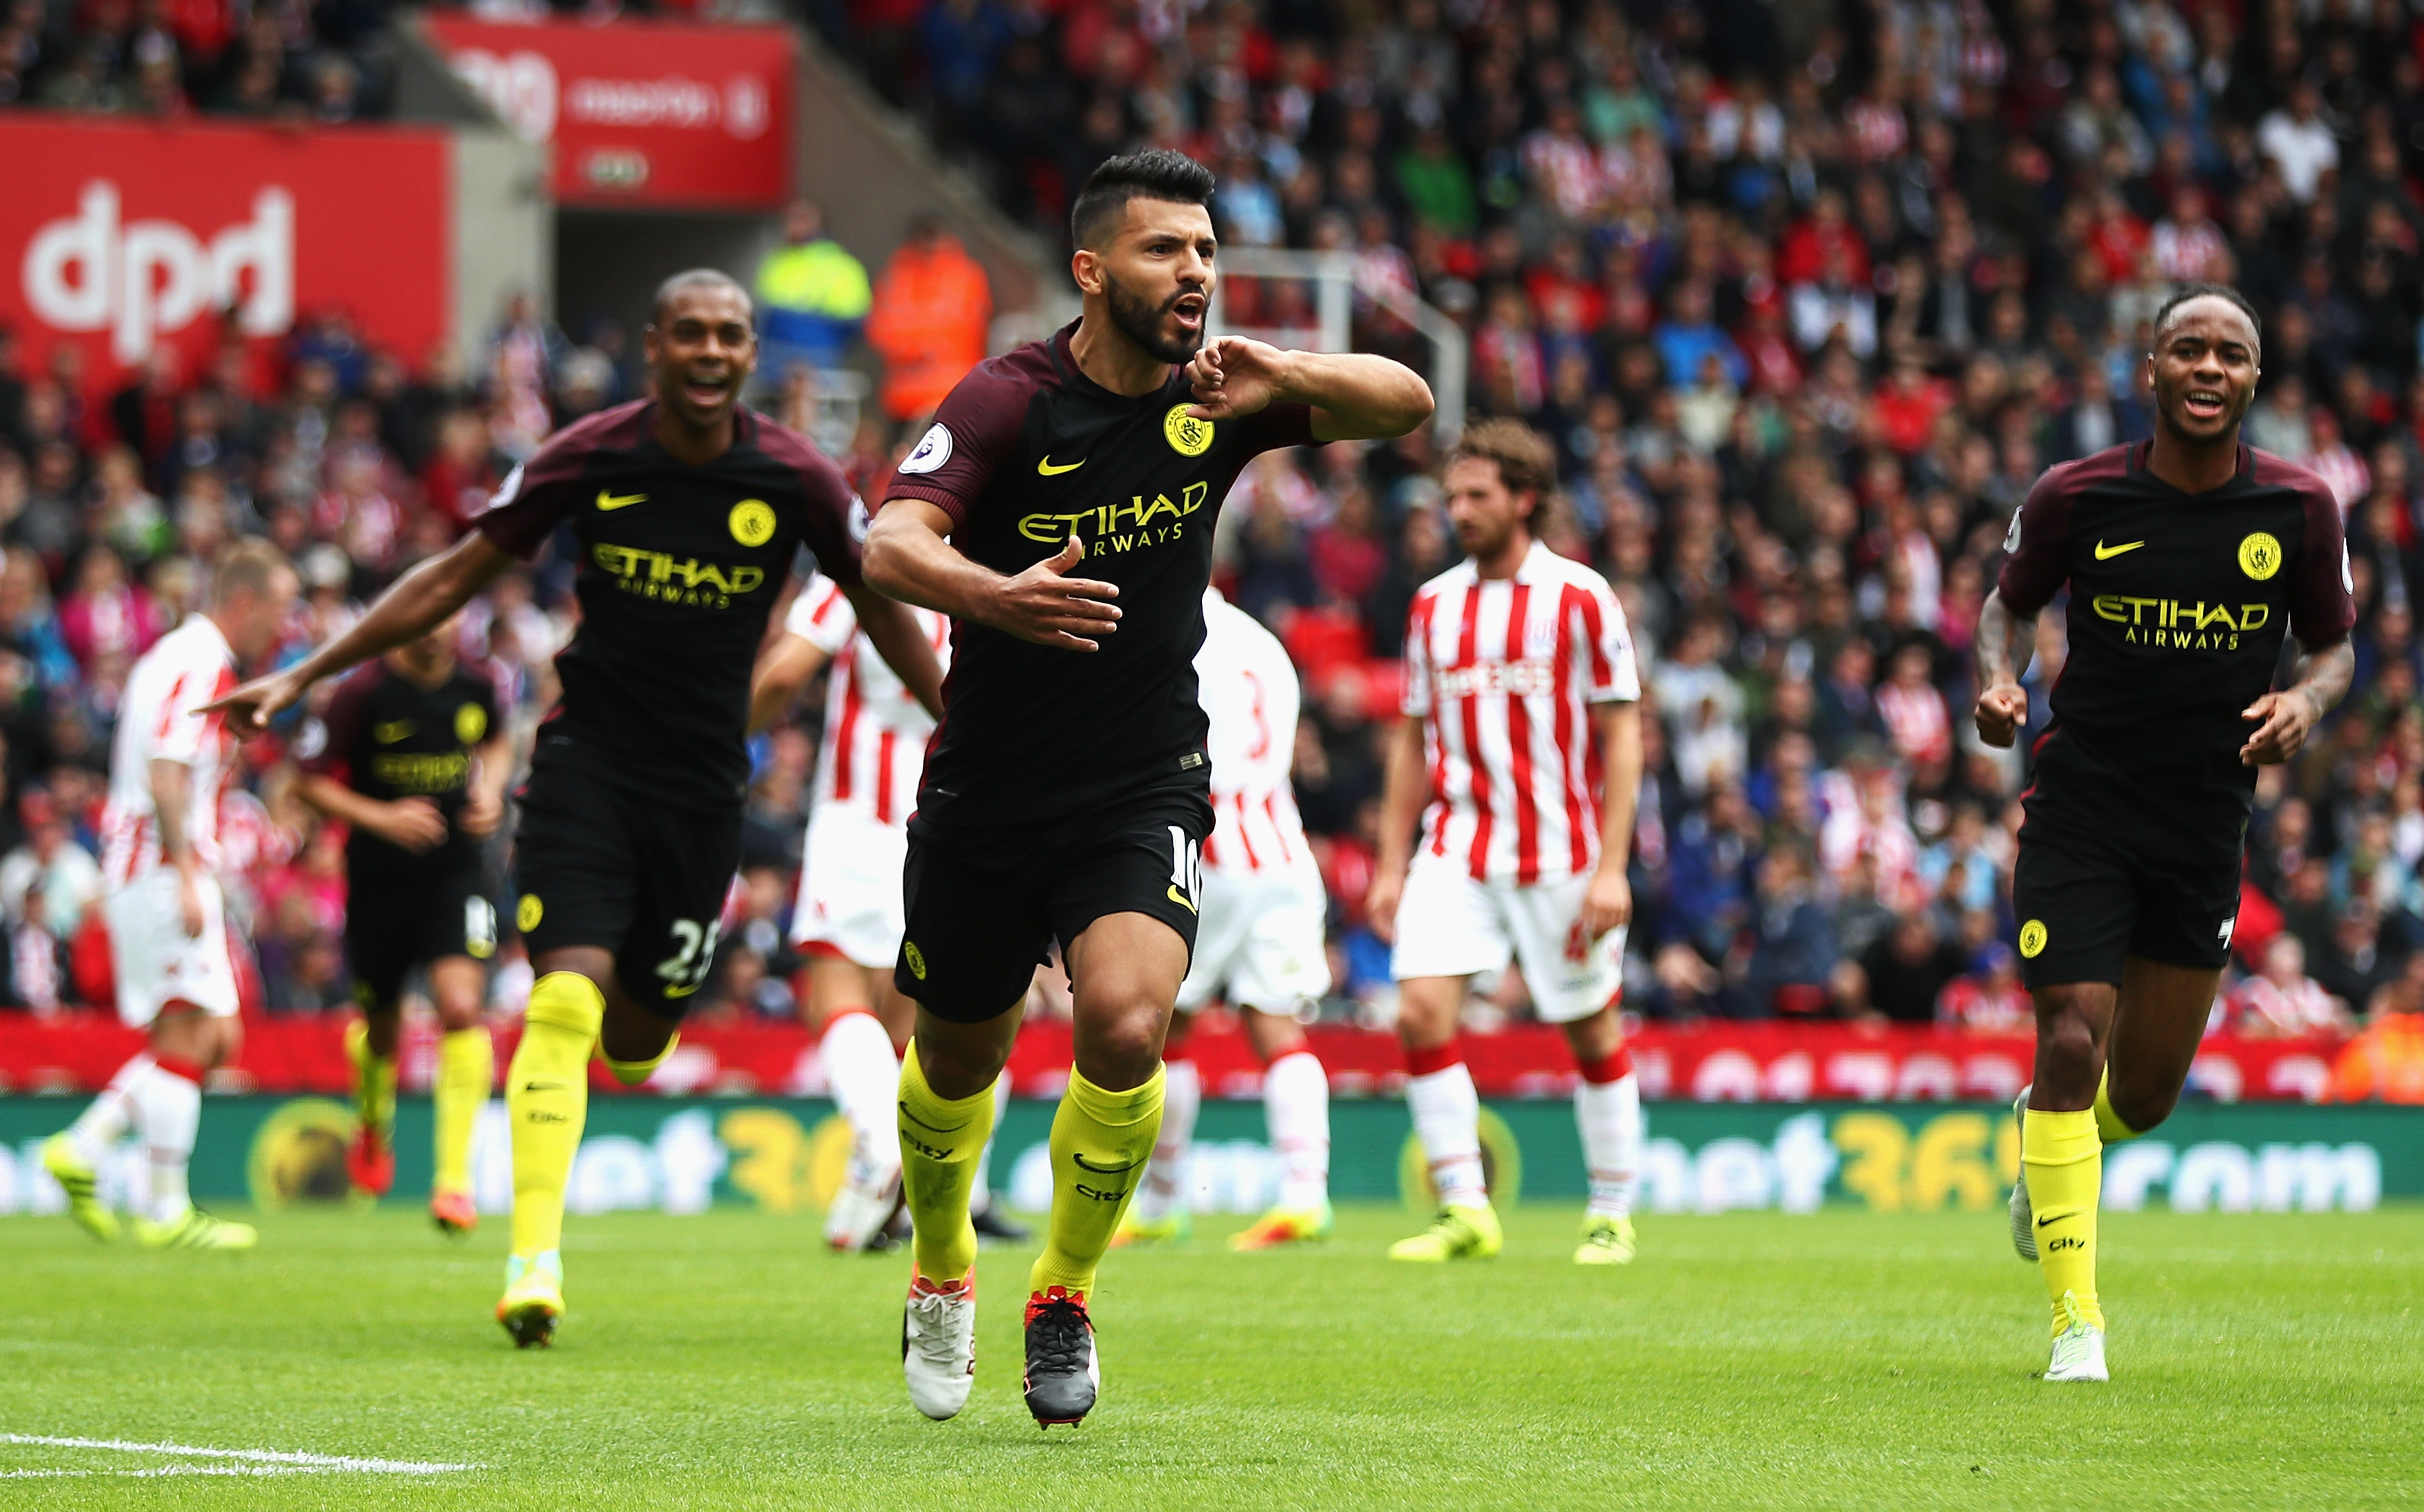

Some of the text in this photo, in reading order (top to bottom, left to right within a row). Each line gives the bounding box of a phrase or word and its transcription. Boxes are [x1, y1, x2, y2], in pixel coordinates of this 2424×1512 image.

[25, 181, 295, 363] dpd
[1017, 480, 1208, 543] ETIHAD
[592, 543, 765, 594] ETIHAD
[616, 578, 731, 610] AIRWAYS
[2093, 595, 2269, 631] ETIHAD
[2125, 626, 2239, 651] AIRWAYS
[1241, 670, 1271, 760] 3
[1167, 825, 1200, 911] 10
